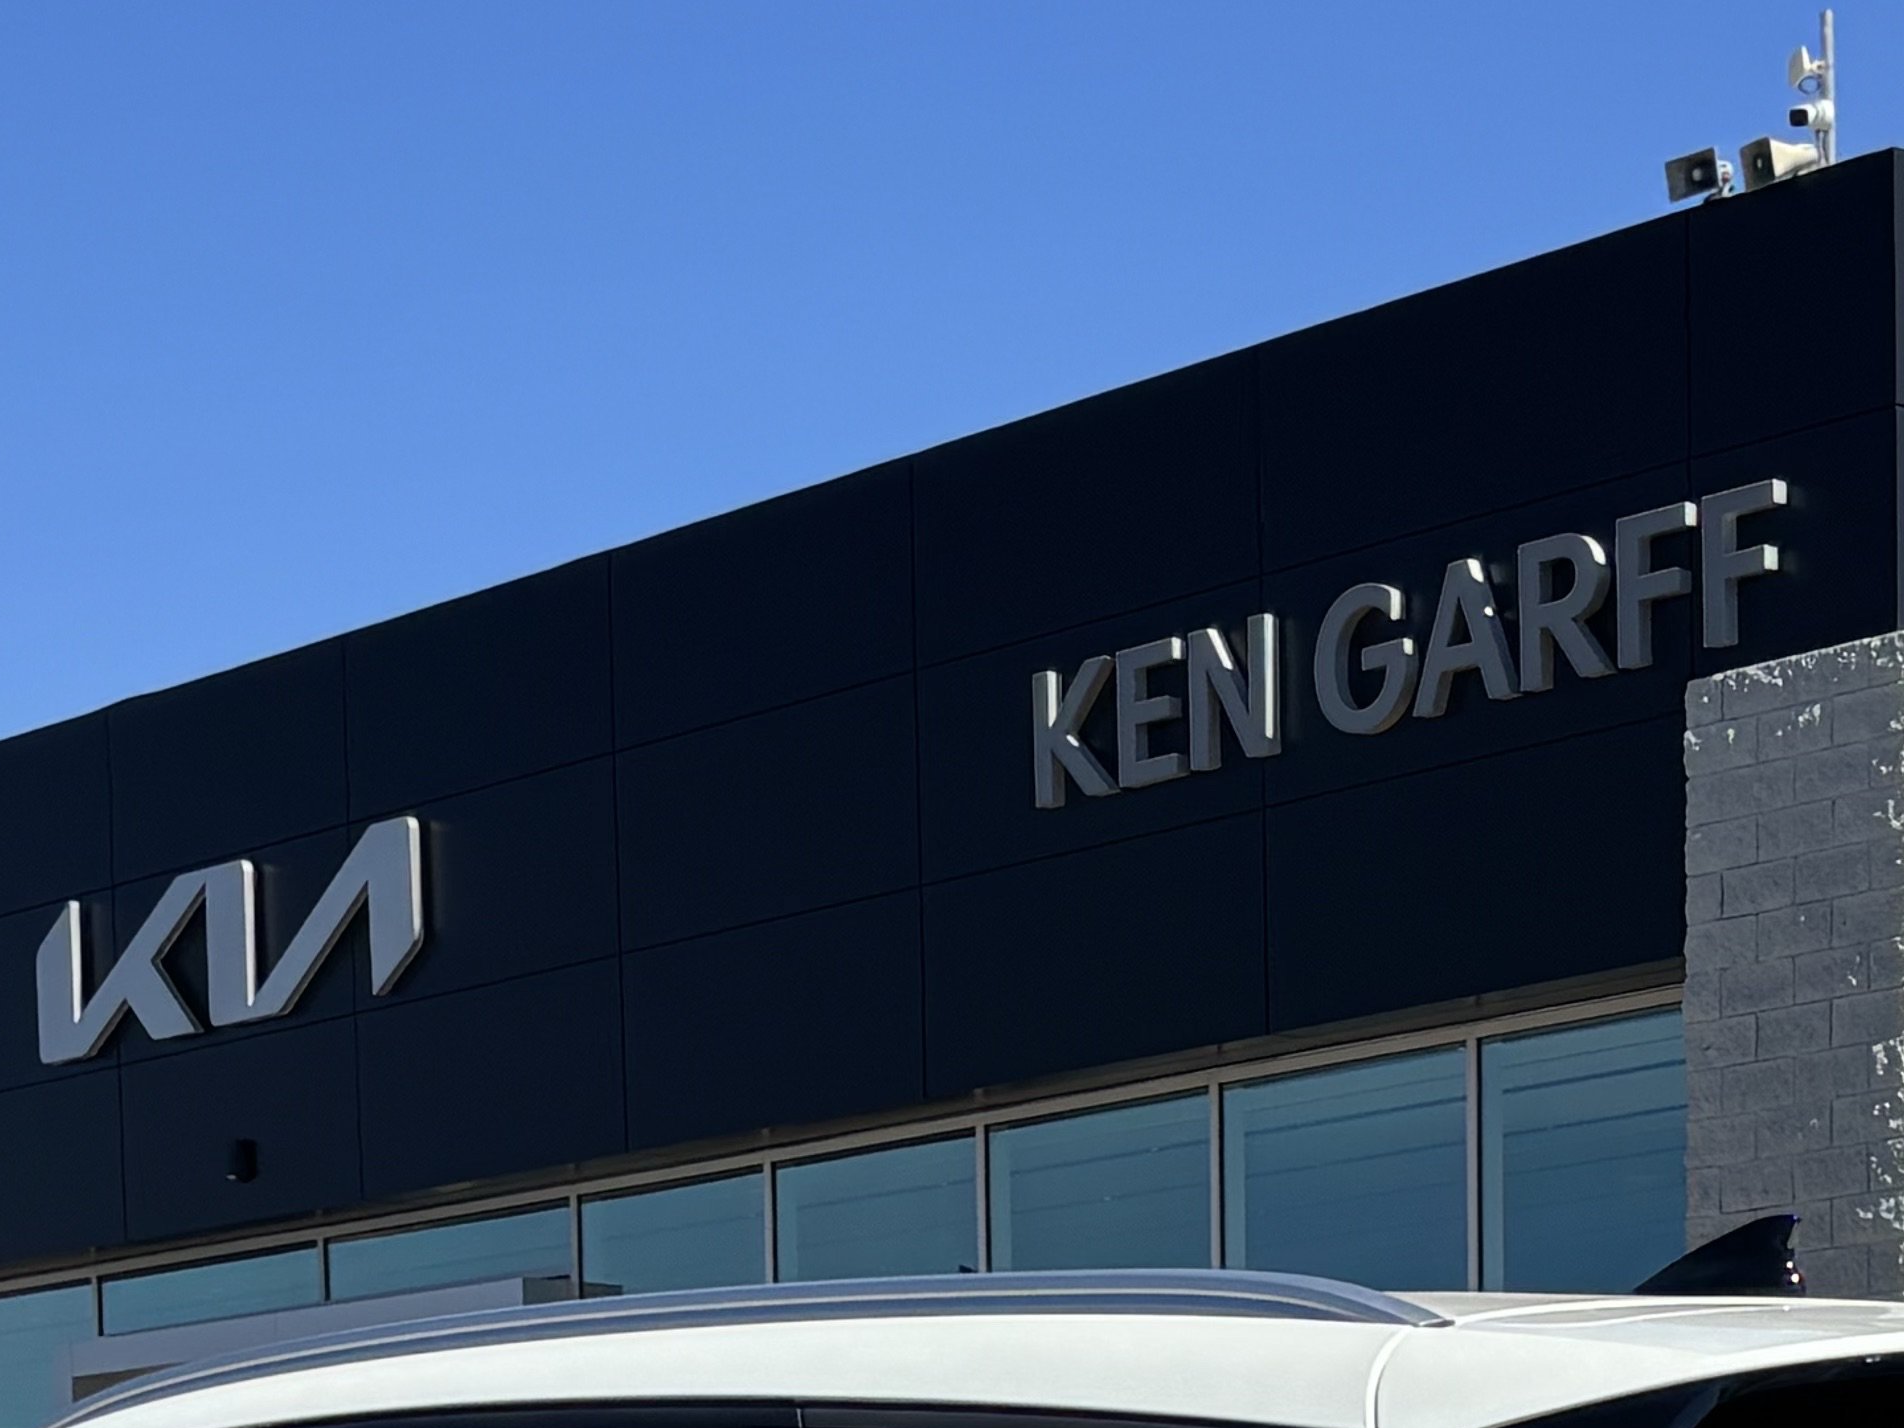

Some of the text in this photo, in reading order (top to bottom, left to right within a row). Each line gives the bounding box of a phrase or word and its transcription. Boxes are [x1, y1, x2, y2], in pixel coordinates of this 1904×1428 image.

[1032, 478, 1788, 809] KEN GARFF
[36, 815, 424, 1066] KIA
